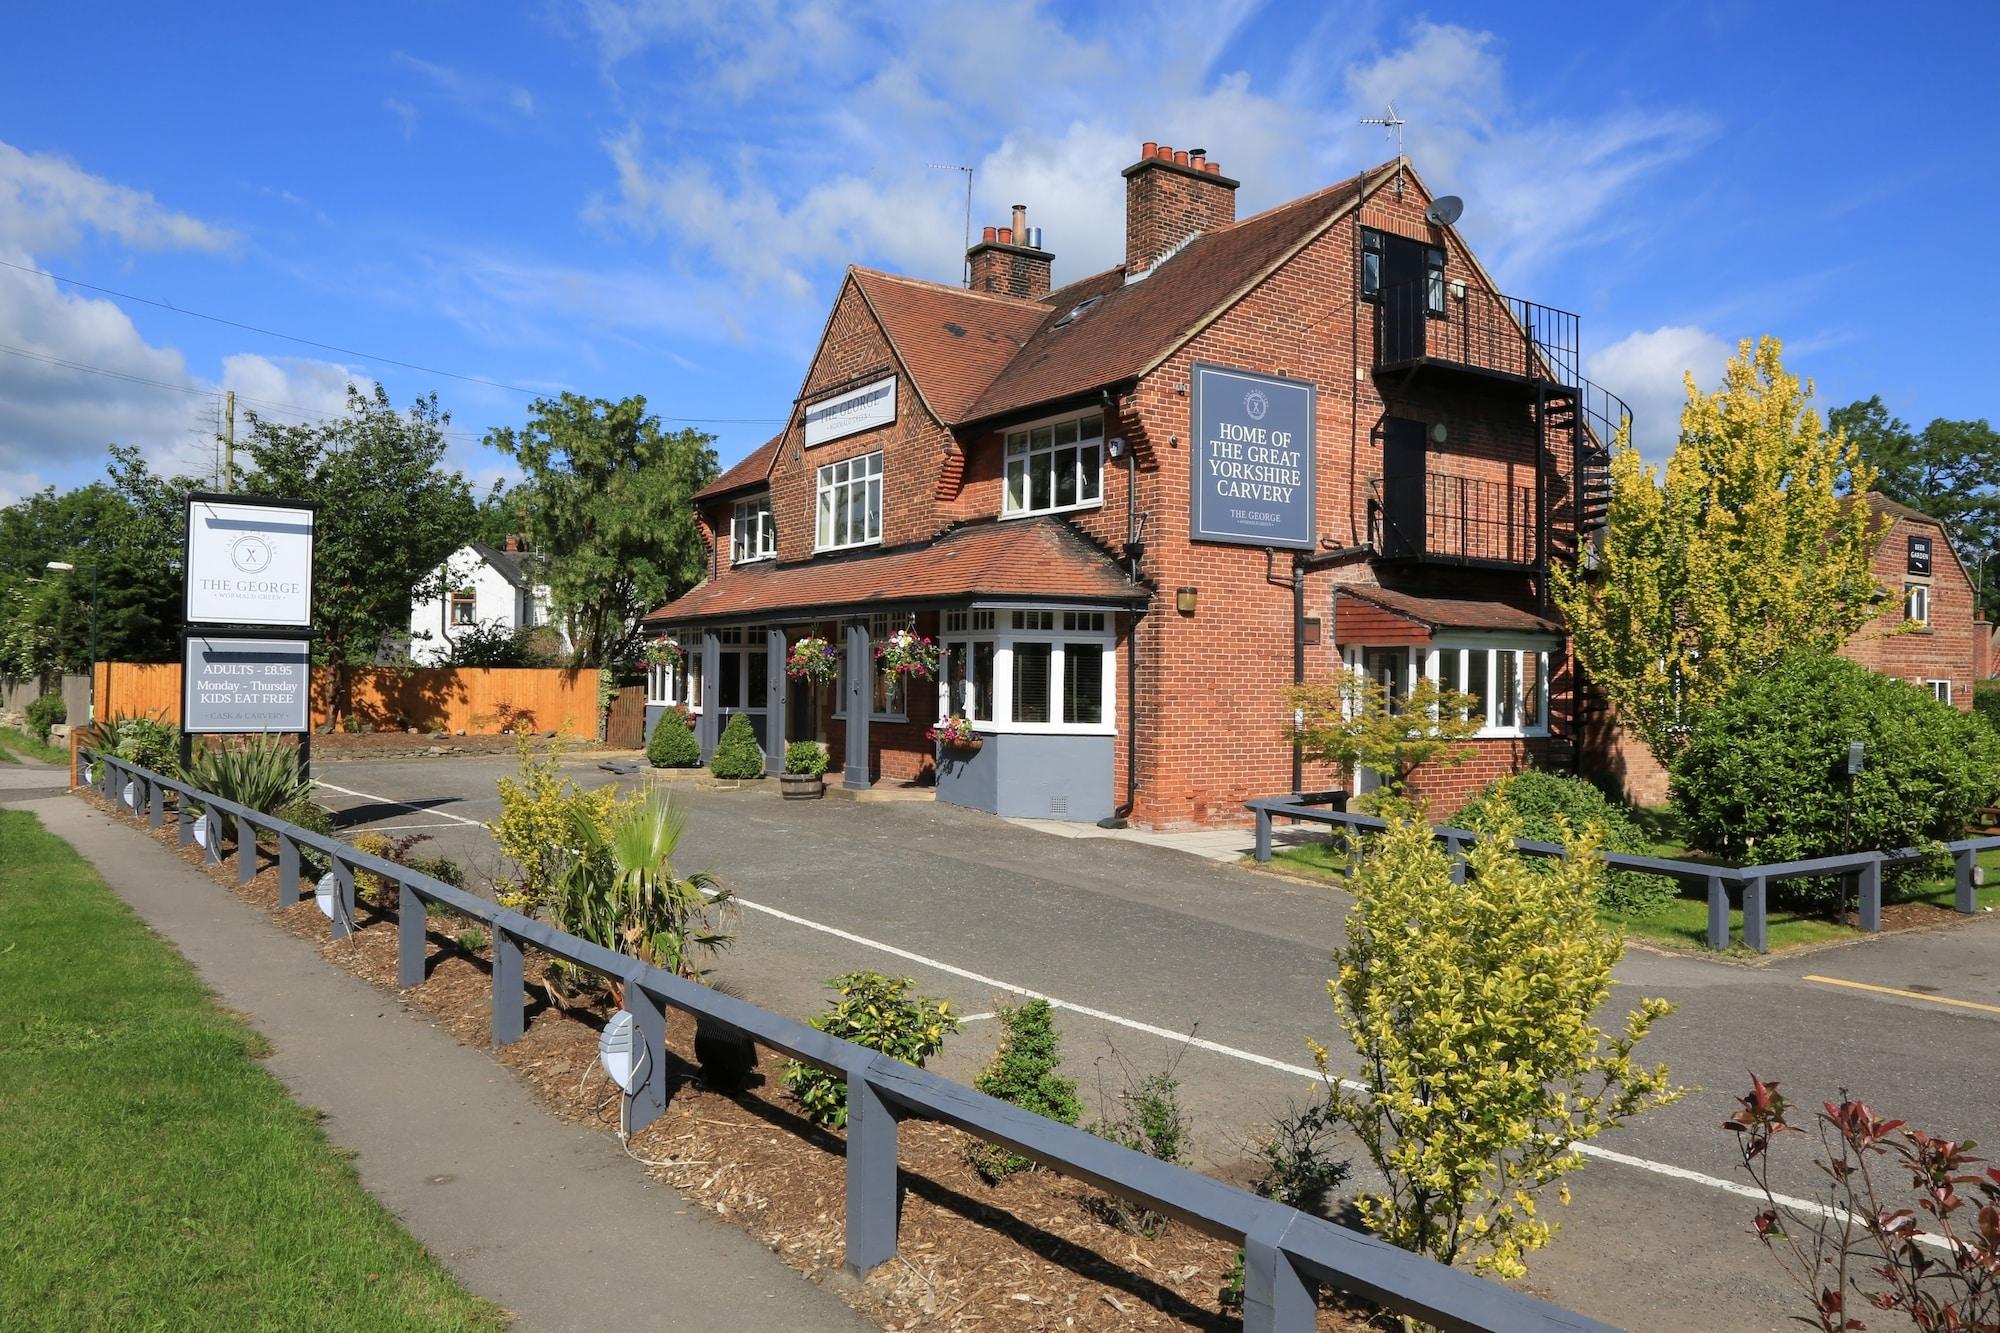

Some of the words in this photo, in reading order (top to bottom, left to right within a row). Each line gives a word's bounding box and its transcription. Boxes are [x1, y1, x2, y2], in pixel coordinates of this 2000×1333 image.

[820, 407, 837, 423] THE
[840, 391, 880, 416] GEORGE
[1219, 423, 1267, 445] HOME
[1271, 431, 1292, 448] OF
[1210, 440, 1243, 460] THE
[1247, 446, 1300, 468] GREAT
[1209, 459, 1301, 486] YORKSHIRE
[1217, 480, 1293, 503] CARVERY
[1230, 509, 1247, 519] THE
[1248, 511, 1281, 523] GEORGE
[199, 579, 231, 591] THE
[237, 580, 300, 594] GEORGE
[203, 664, 254, 675] ADULTS
[264, 665, 293, 676] £8.95
[197, 680, 240, 693] Monday
[250, 681, 298, 694] Thursday
[201, 693, 231, 704] KIDS
[235, 693, 260, 704] EAT
[262, 694, 294, 704] FREE
